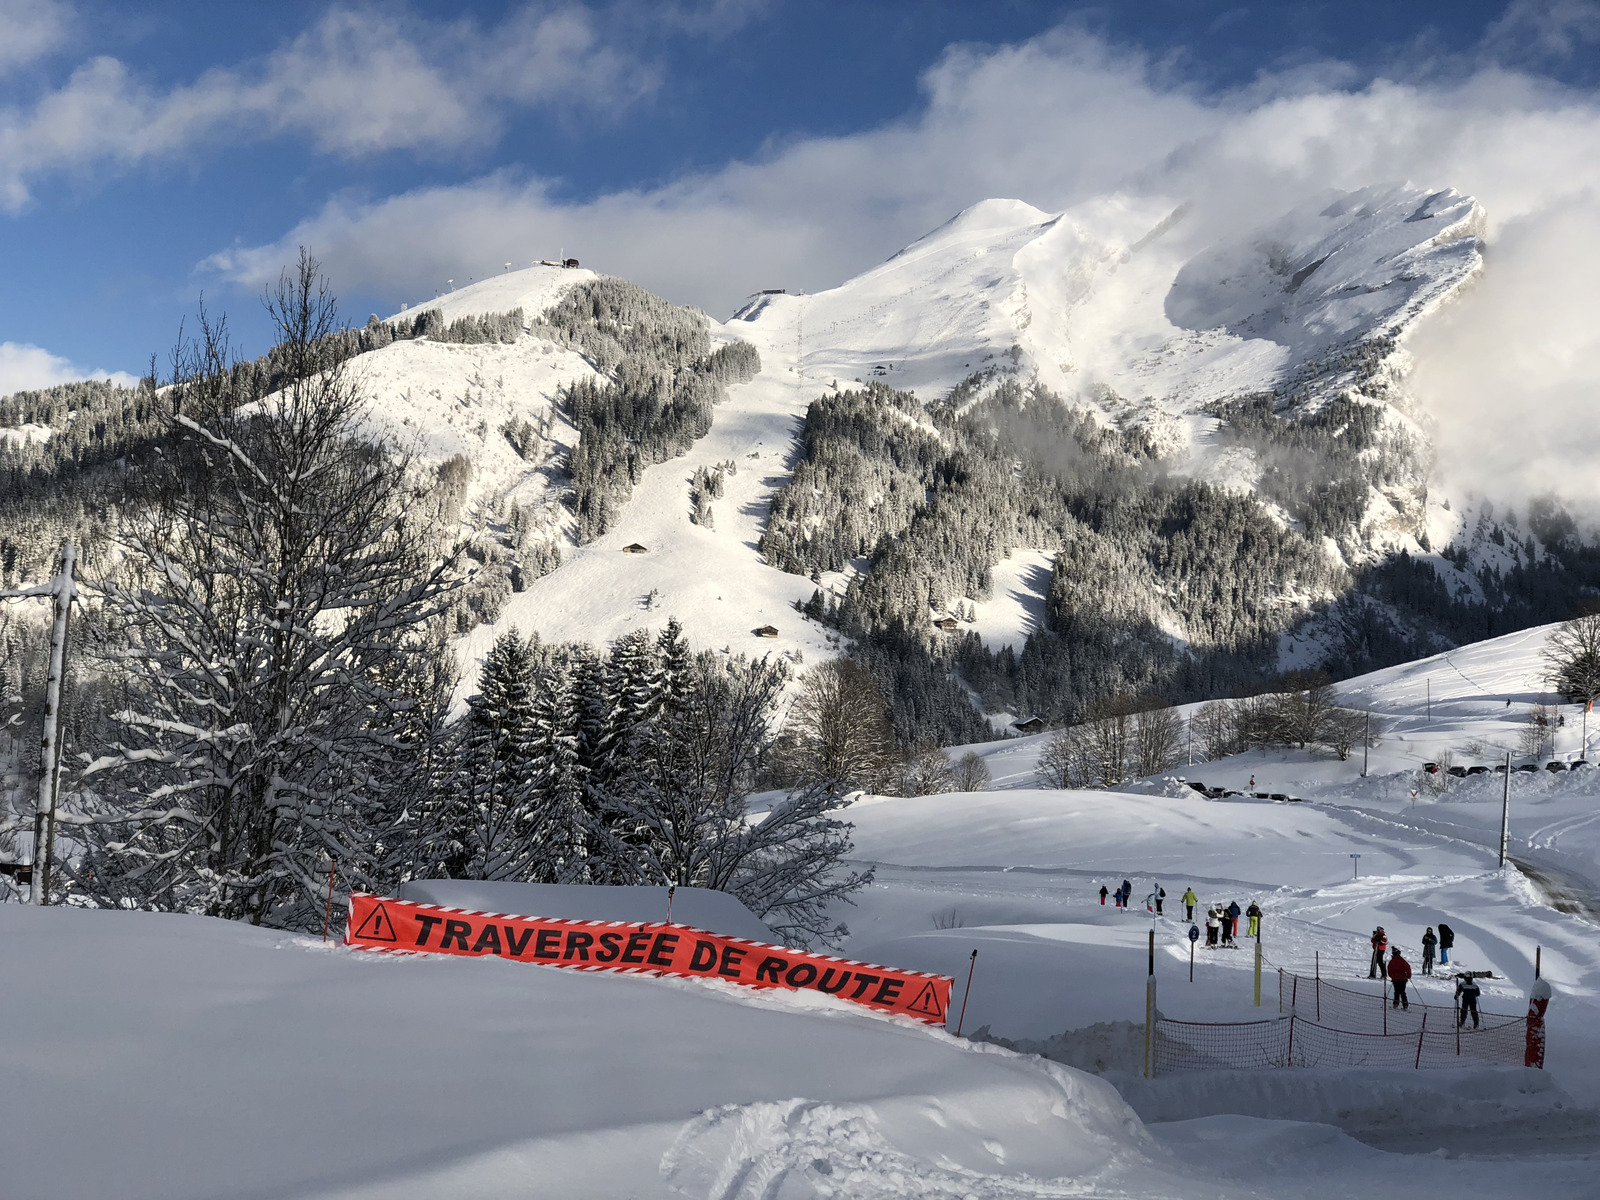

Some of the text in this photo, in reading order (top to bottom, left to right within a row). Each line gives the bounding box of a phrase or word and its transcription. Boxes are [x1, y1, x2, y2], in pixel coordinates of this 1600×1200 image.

[415, 914, 904, 1006] TRAVERSÉE DE ROUTE
